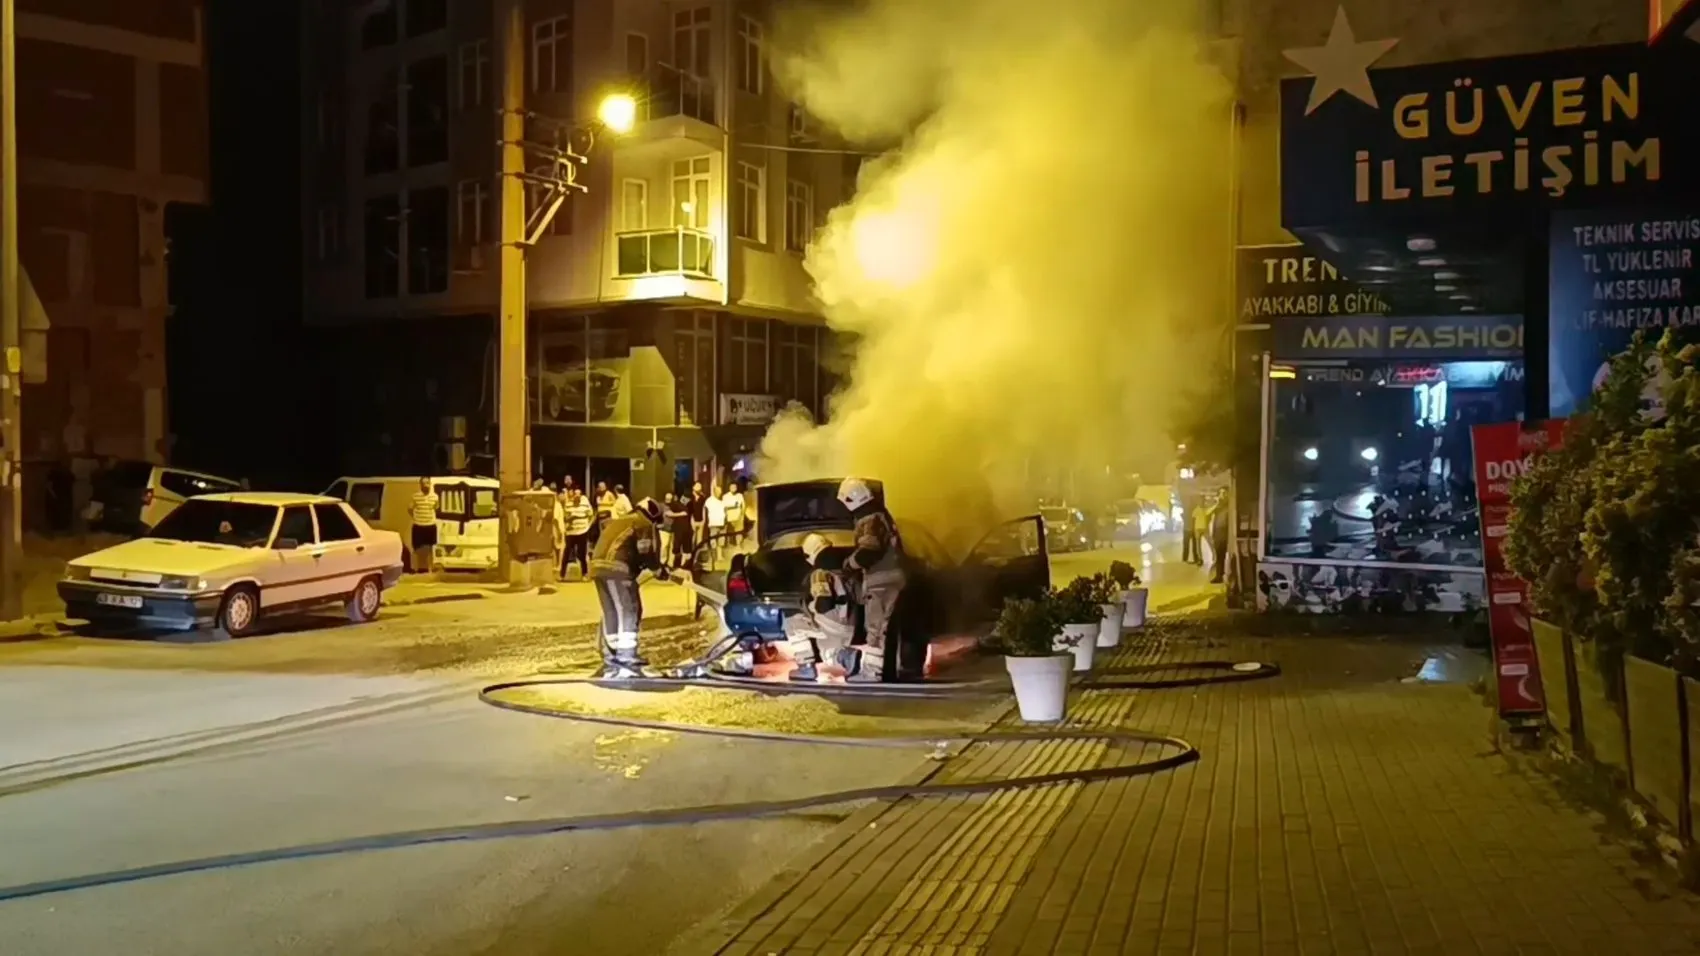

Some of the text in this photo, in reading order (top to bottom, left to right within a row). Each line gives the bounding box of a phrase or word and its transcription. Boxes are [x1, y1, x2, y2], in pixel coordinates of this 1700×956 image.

[1393, 72, 1640, 139] GÜVEN
[1355, 130, 1661, 203] İLETİŞİM
[1263, 256, 1348, 284] TREN
[1582, 253, 1602, 274] TL
[1593, 276, 1682, 301] AKSESUAR
[1242, 294, 1324, 317] AYAKKABI
[1328, 293, 1339, 314] &
[1301, 326, 1379, 349] MAN
[1485, 459, 1532, 481] DOY
